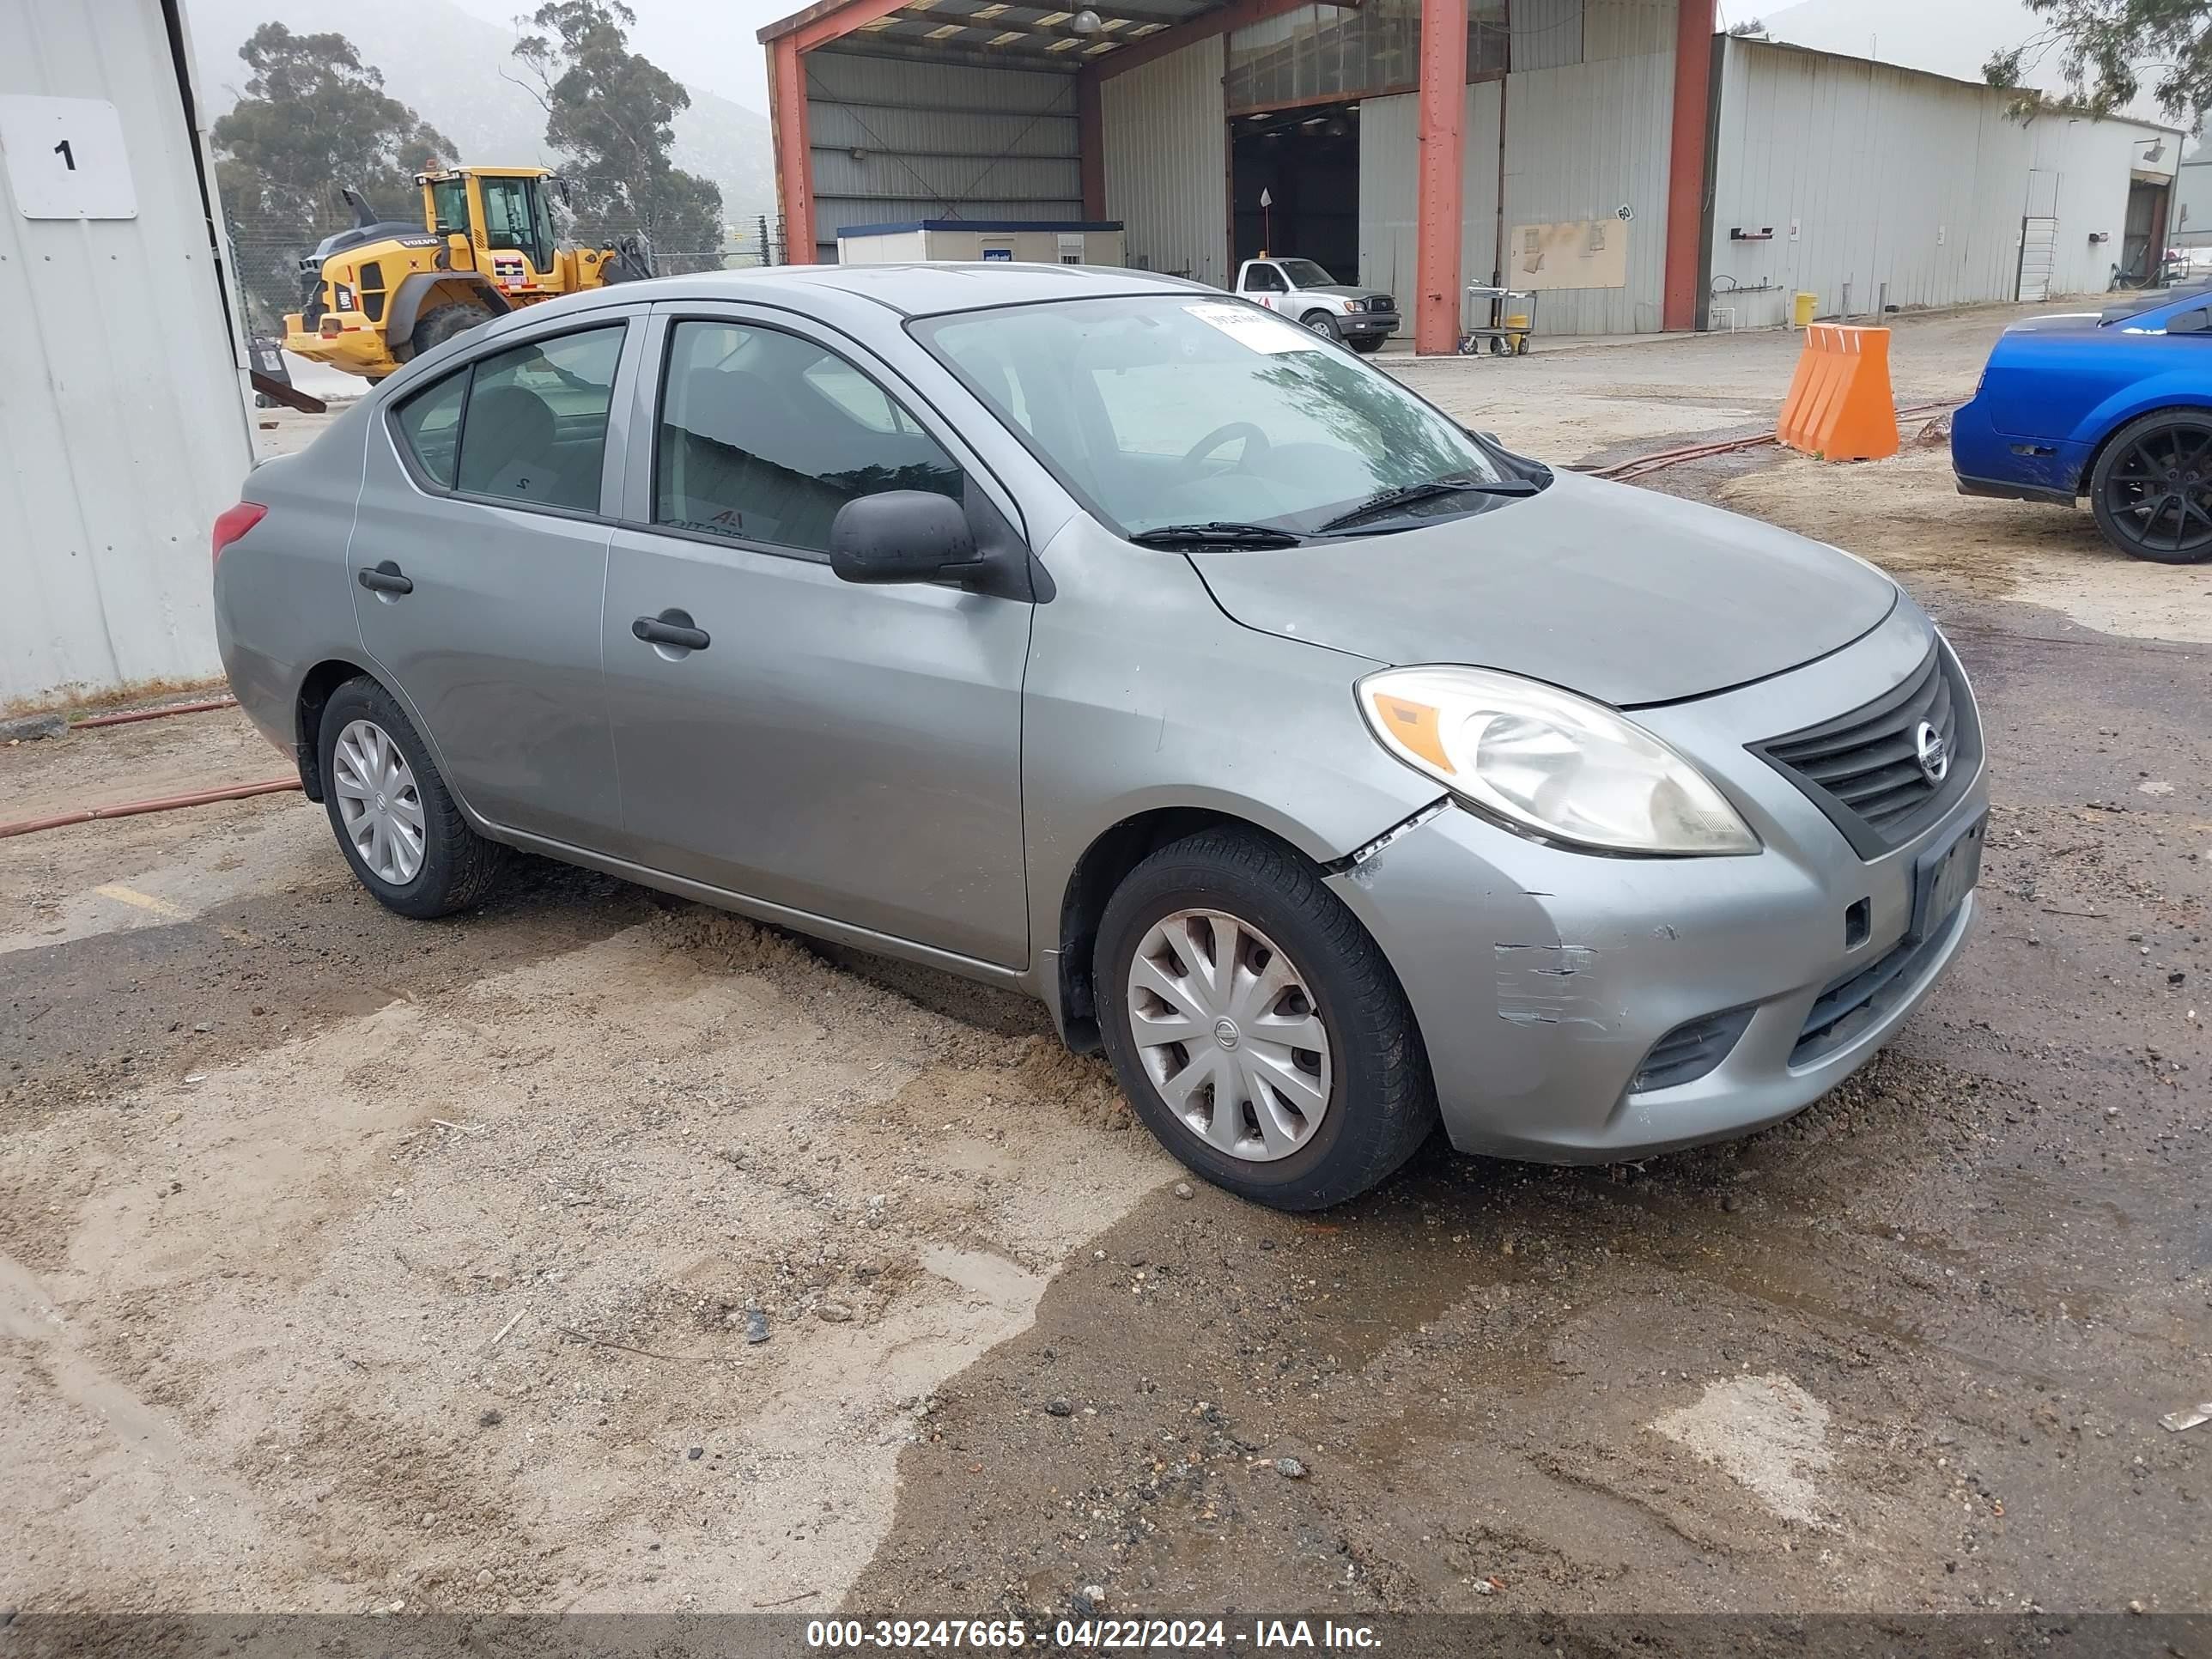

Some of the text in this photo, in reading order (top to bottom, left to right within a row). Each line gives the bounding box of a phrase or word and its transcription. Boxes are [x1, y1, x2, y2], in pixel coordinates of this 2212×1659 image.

[54, 139, 76, 171] 1
[1618, 206, 1631, 221] 60
[402, 238, 439, 246] VOLVO
[337, 291, 352, 310] L90H
